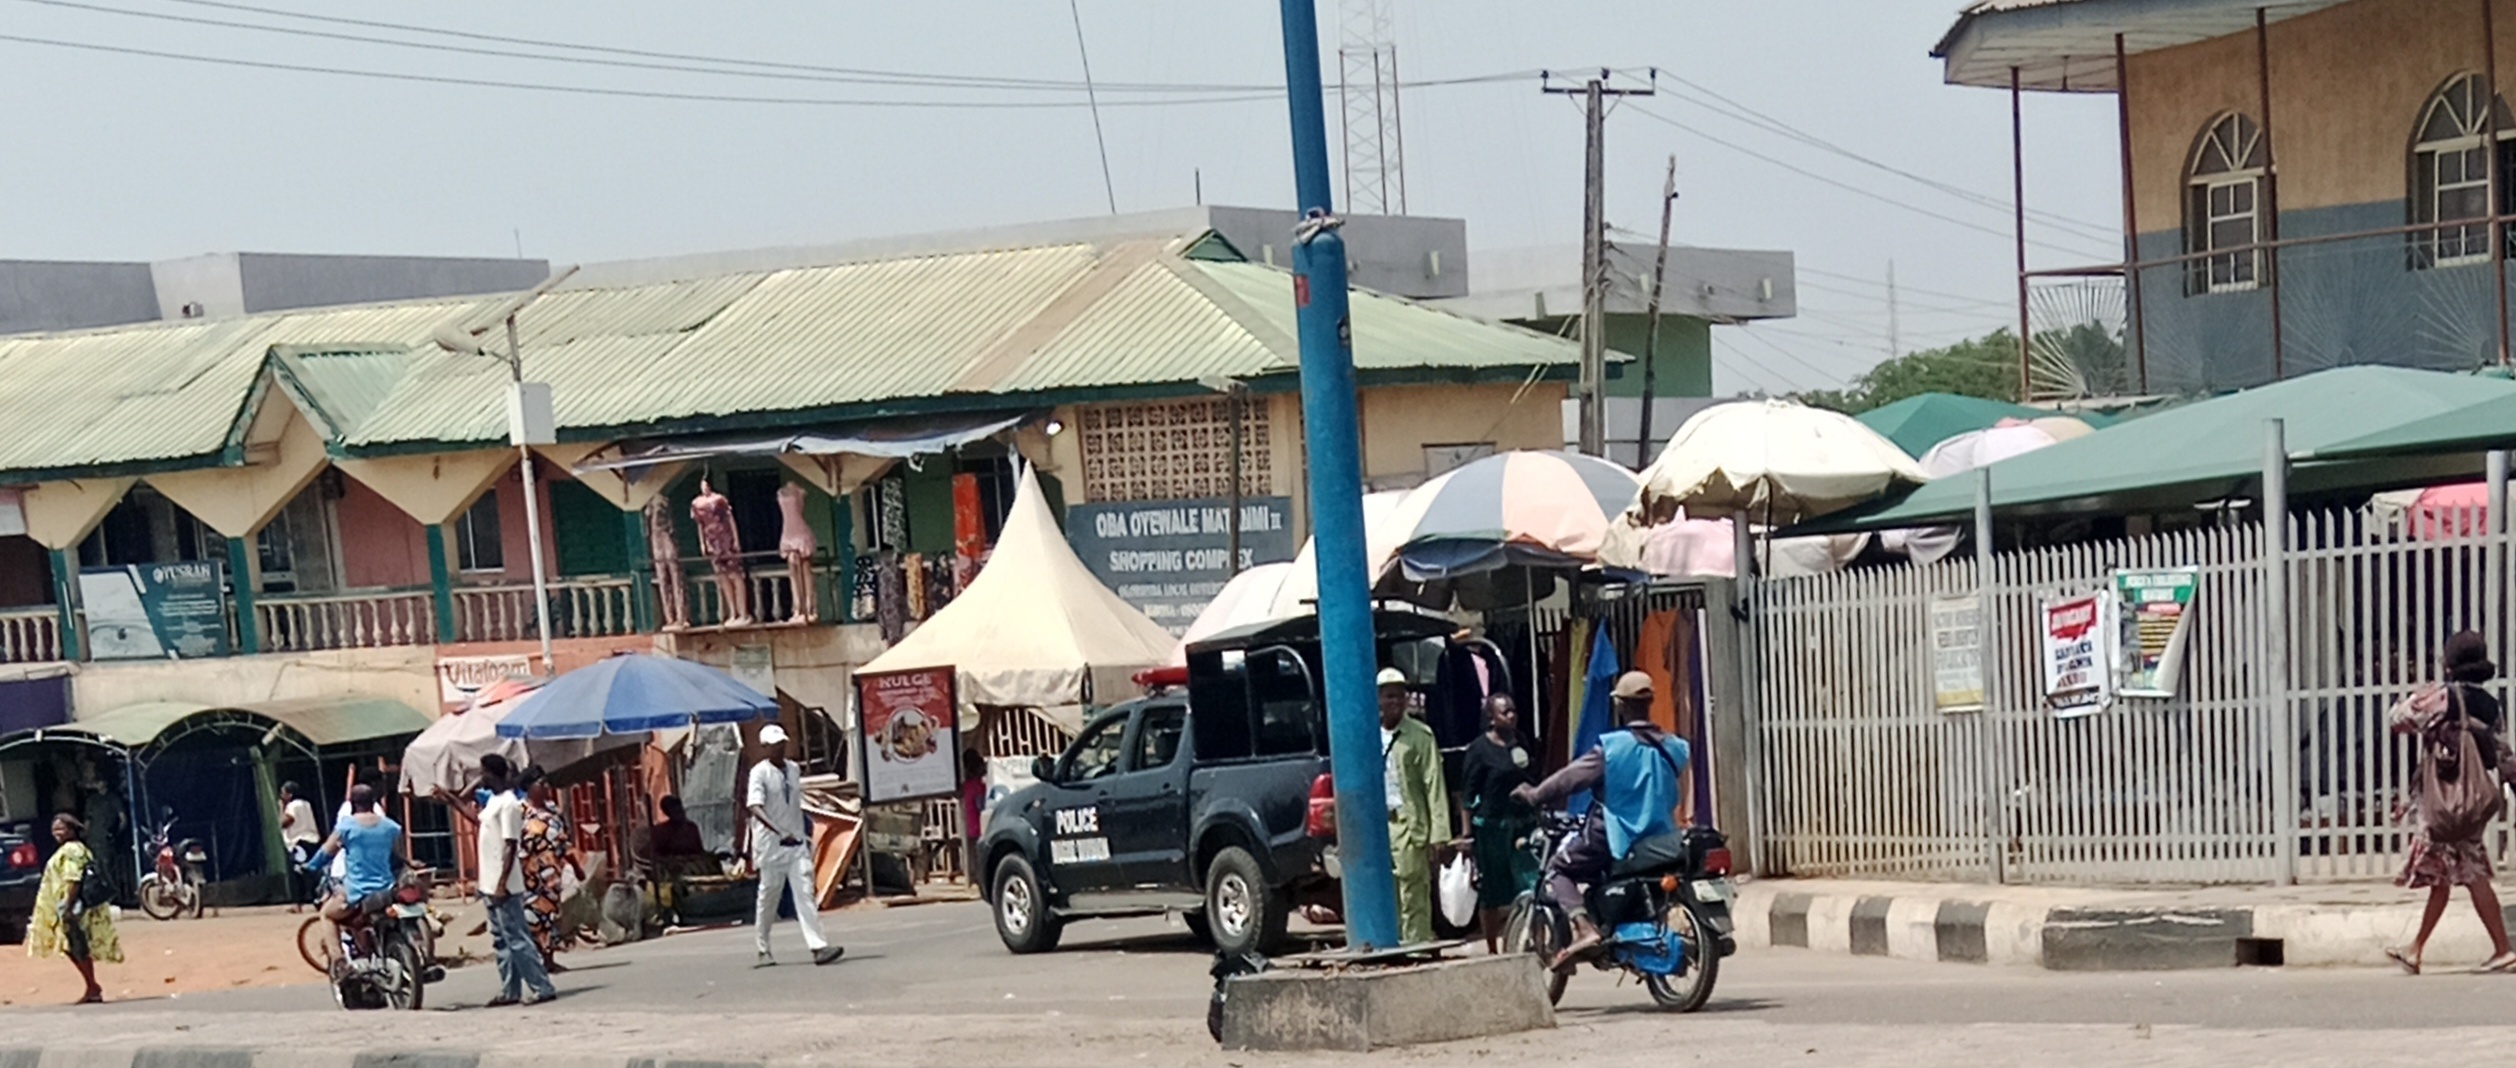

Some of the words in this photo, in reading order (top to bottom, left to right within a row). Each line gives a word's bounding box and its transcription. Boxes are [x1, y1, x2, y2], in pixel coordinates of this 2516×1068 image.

[1096, 511, 1127, 538] OBA
[1130, 508, 1197, 536] OYEWALE
[1109, 550, 1182, 572] SHOPPING
[1055, 806, 1099, 835] POLICE
